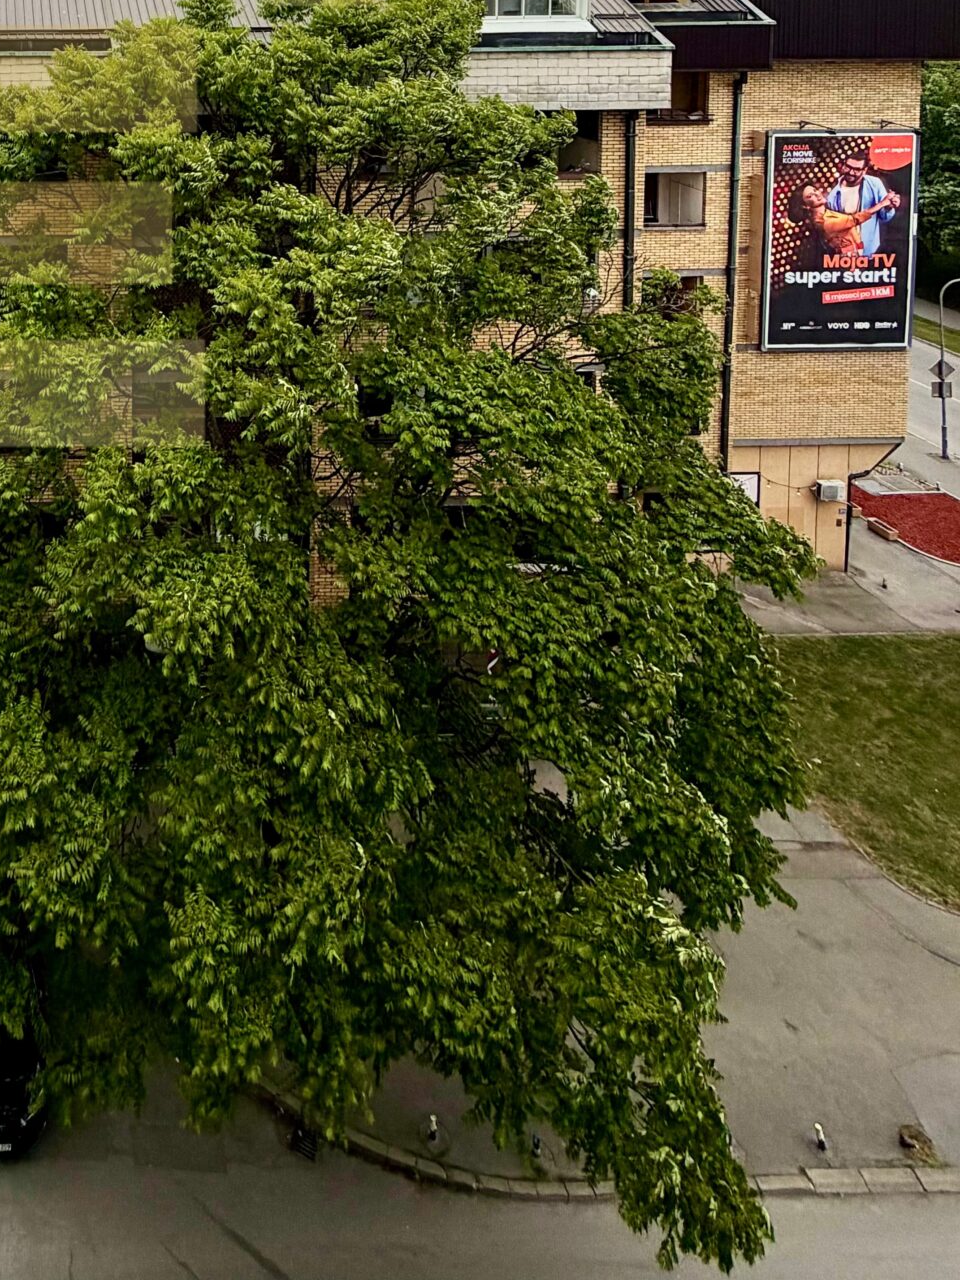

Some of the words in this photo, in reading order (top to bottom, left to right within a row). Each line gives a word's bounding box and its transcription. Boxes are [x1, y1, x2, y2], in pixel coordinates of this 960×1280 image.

[823, 254, 868, 271] Moja
[871, 253, 896, 268] TV
[784, 271, 840, 288] super
[843, 267, 897, 283] start!
[876, 287, 890, 295] KM
